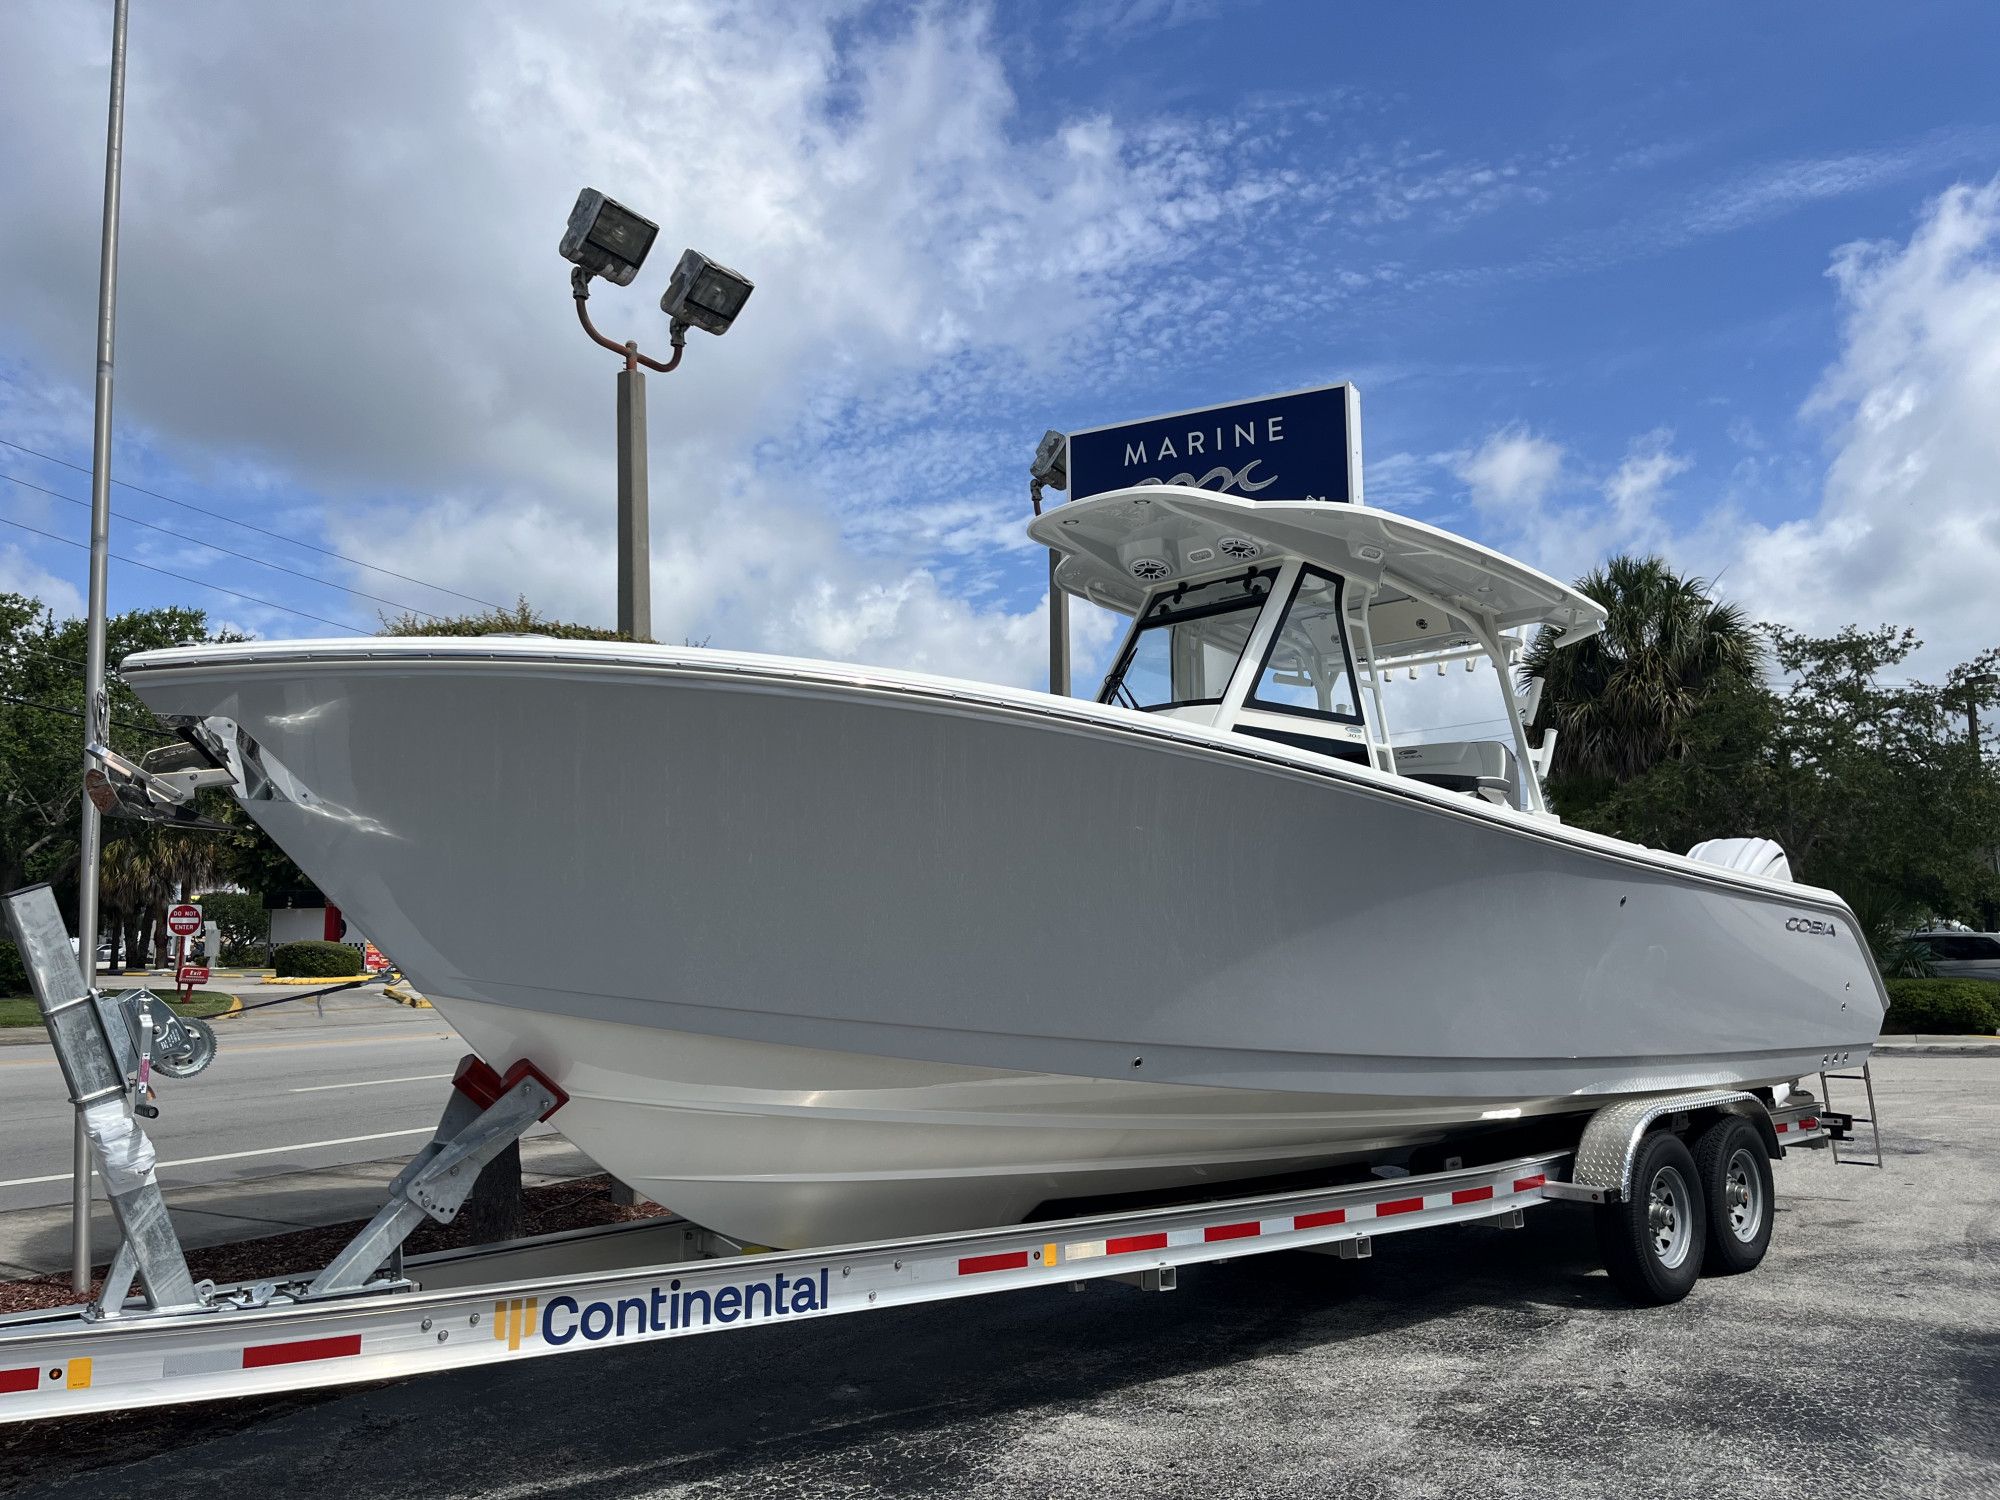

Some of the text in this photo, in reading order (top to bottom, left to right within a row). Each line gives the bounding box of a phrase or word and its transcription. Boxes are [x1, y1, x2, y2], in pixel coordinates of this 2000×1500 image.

[1124, 416, 1284, 466] MARINE
[1785, 917, 1836, 937] COBIA
[542, 1267, 829, 1346] Continental
